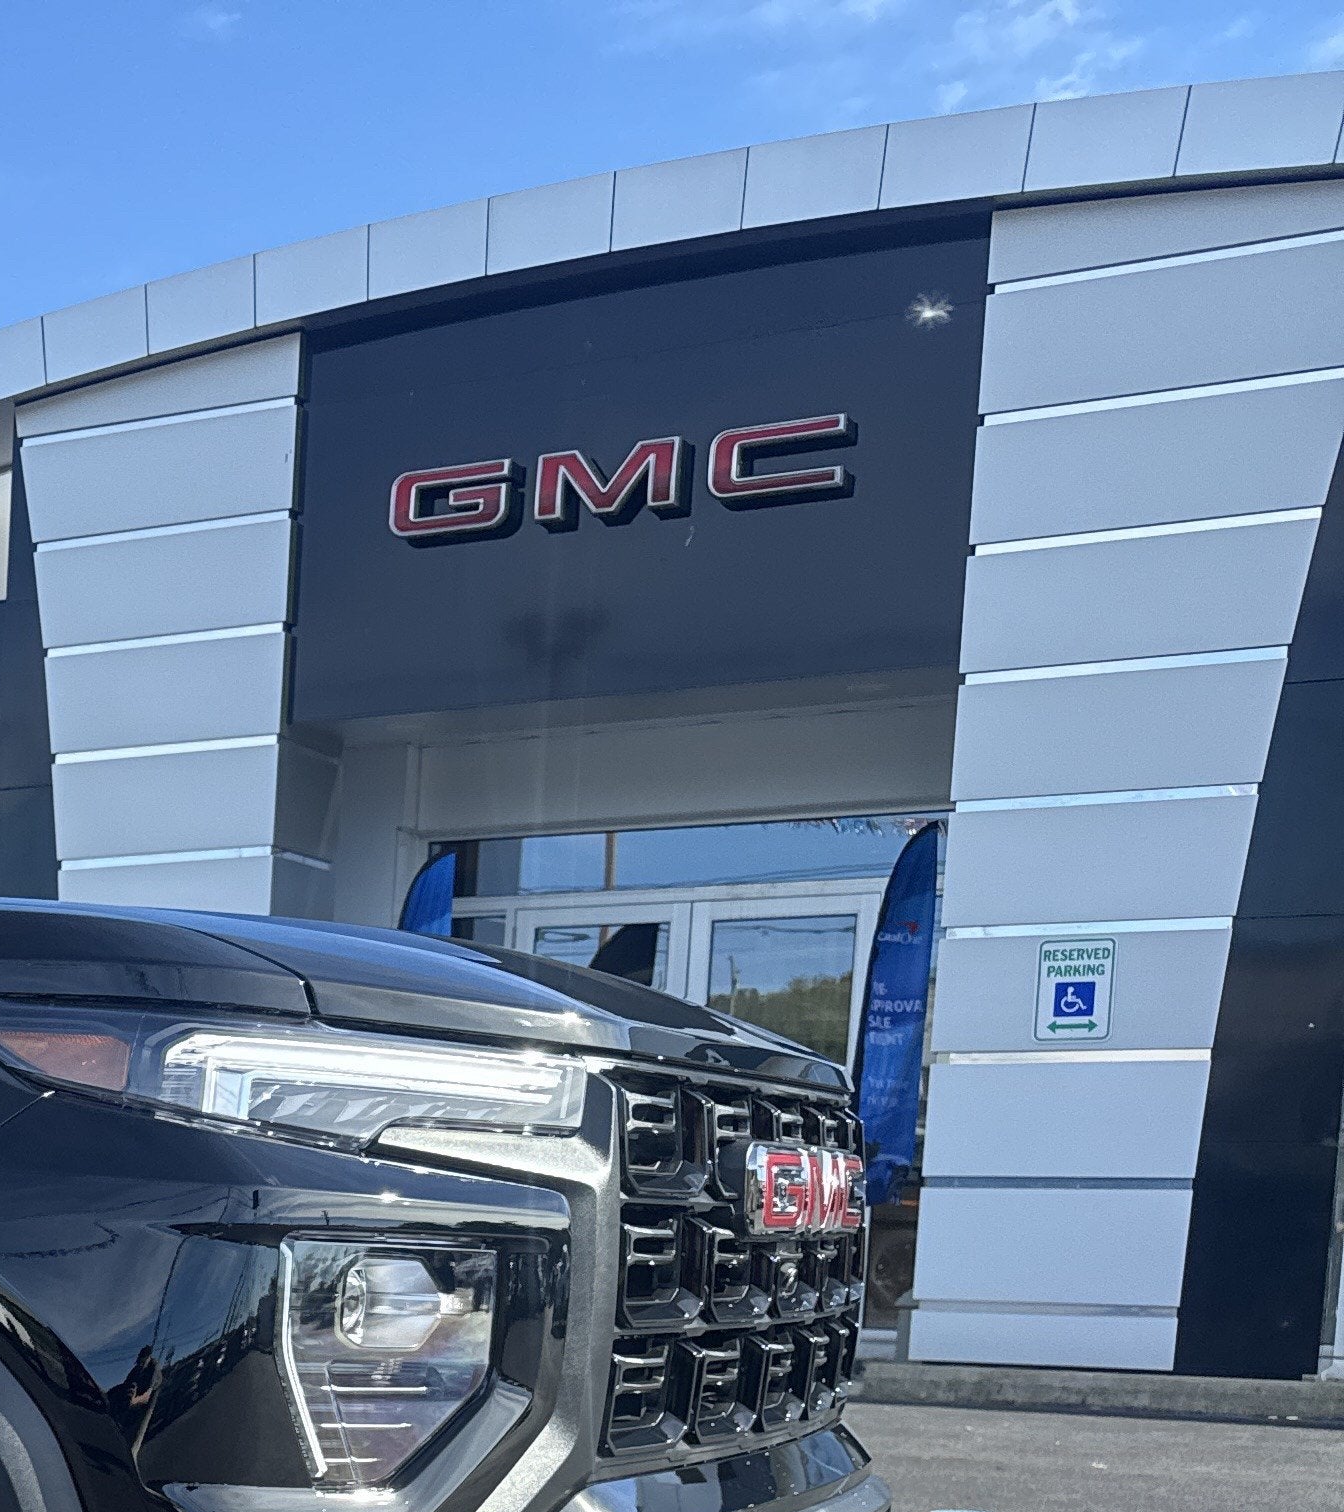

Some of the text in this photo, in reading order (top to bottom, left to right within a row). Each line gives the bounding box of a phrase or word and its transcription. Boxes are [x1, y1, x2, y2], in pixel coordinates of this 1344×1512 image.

[389, 413, 852, 538] GMC
[1043, 947, 1111, 962] RESERVED
[1047, 963, 1105, 978] PARKING
[762, 1147, 864, 1231] GMC
